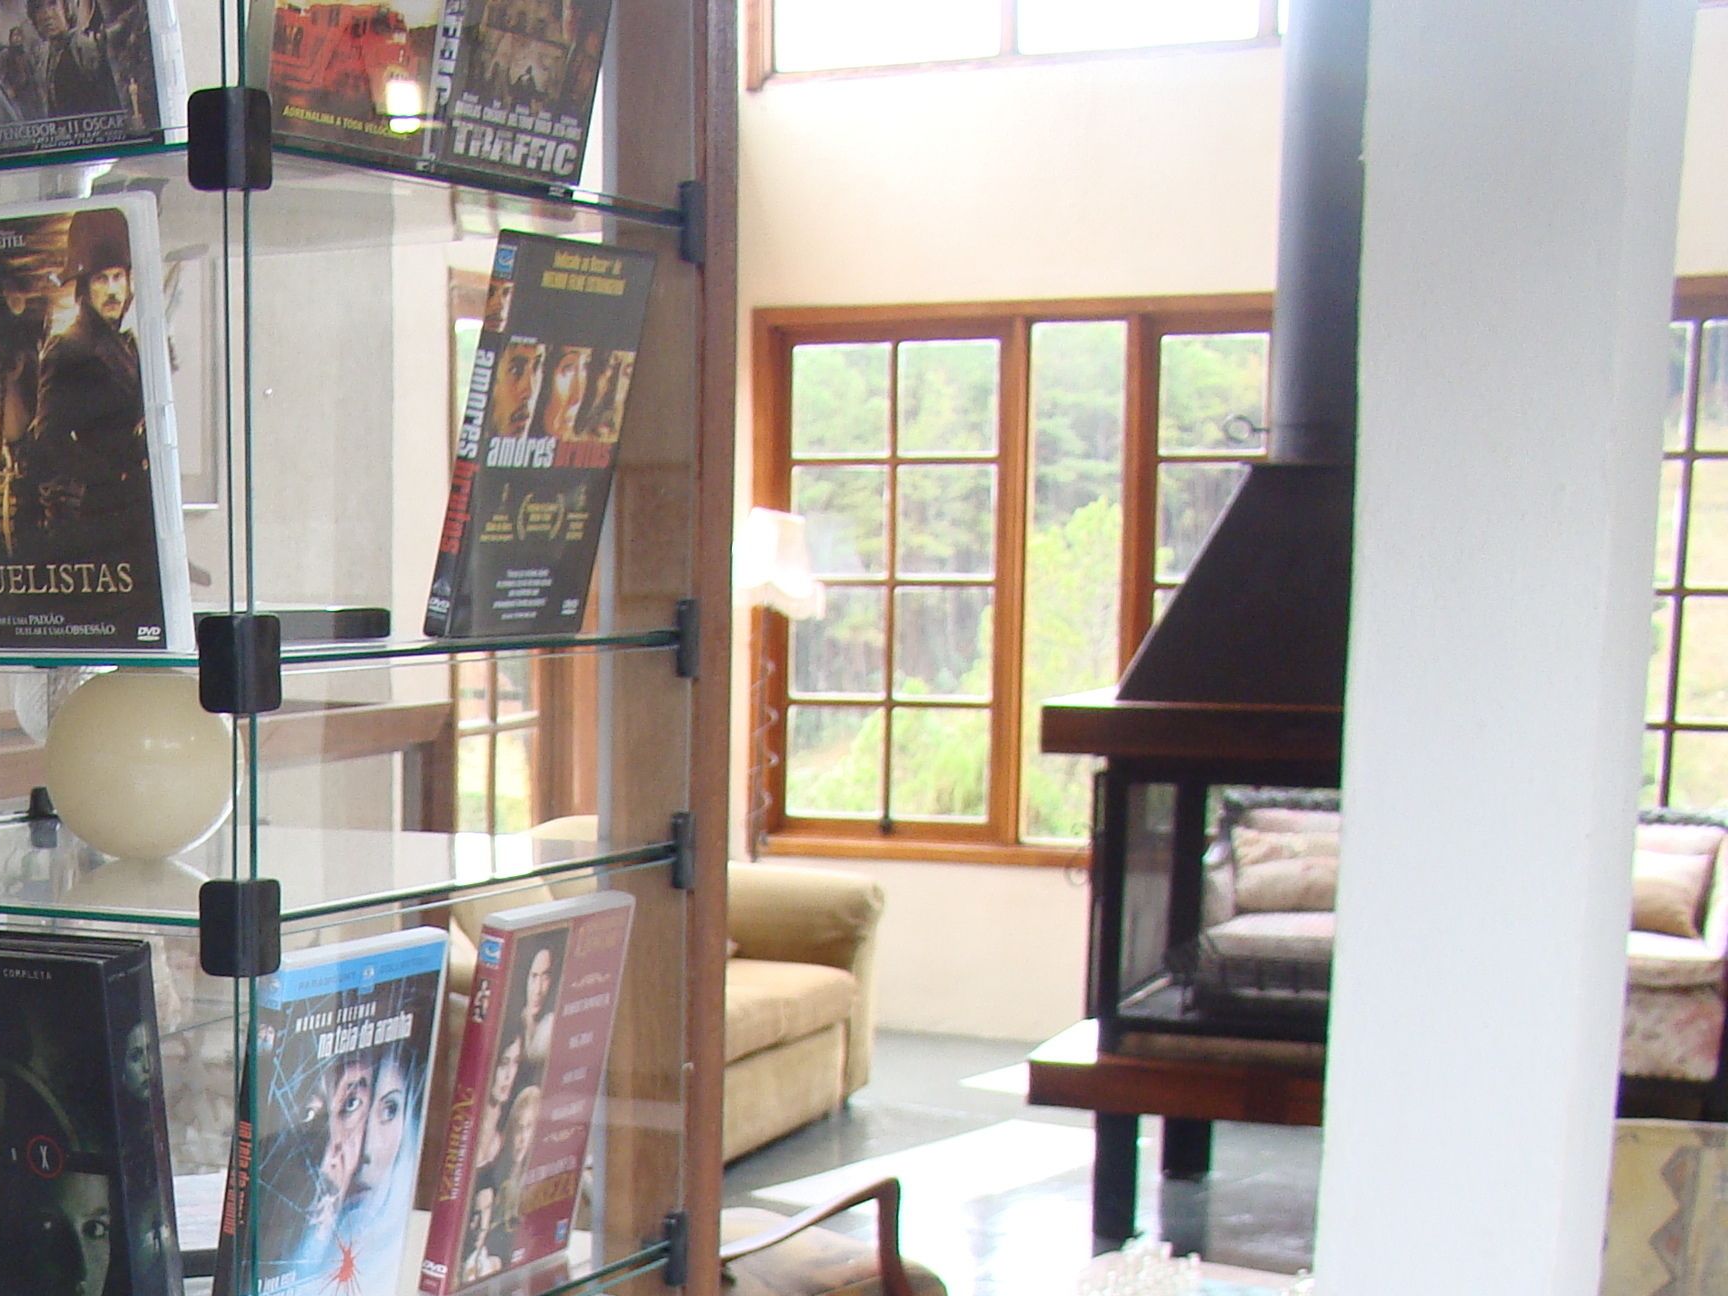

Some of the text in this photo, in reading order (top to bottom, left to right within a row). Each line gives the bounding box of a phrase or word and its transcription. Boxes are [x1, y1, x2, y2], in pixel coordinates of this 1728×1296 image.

[282, 104, 333, 126] ADRENALINA
[452, 119, 578, 177] TRAFFIC
[458, 349, 496, 459] amores
[486, 436, 557, 468] amores
[439, 459, 480, 554] brutos
[28, 612, 65, 625] PAIXÃO
[65, 621, 116, 636] OBSESSÃO
[137, 626, 162, 636] DVD
[2, 968, 53, 981] COMPLETA
[295, 1001, 377, 1033] MORGAN FREEMAN
[317, 1011, 414, 1059] na teia da aranha
[38, 1144, 50, 1170] X
[421, 1258, 447, 1273] DVD
